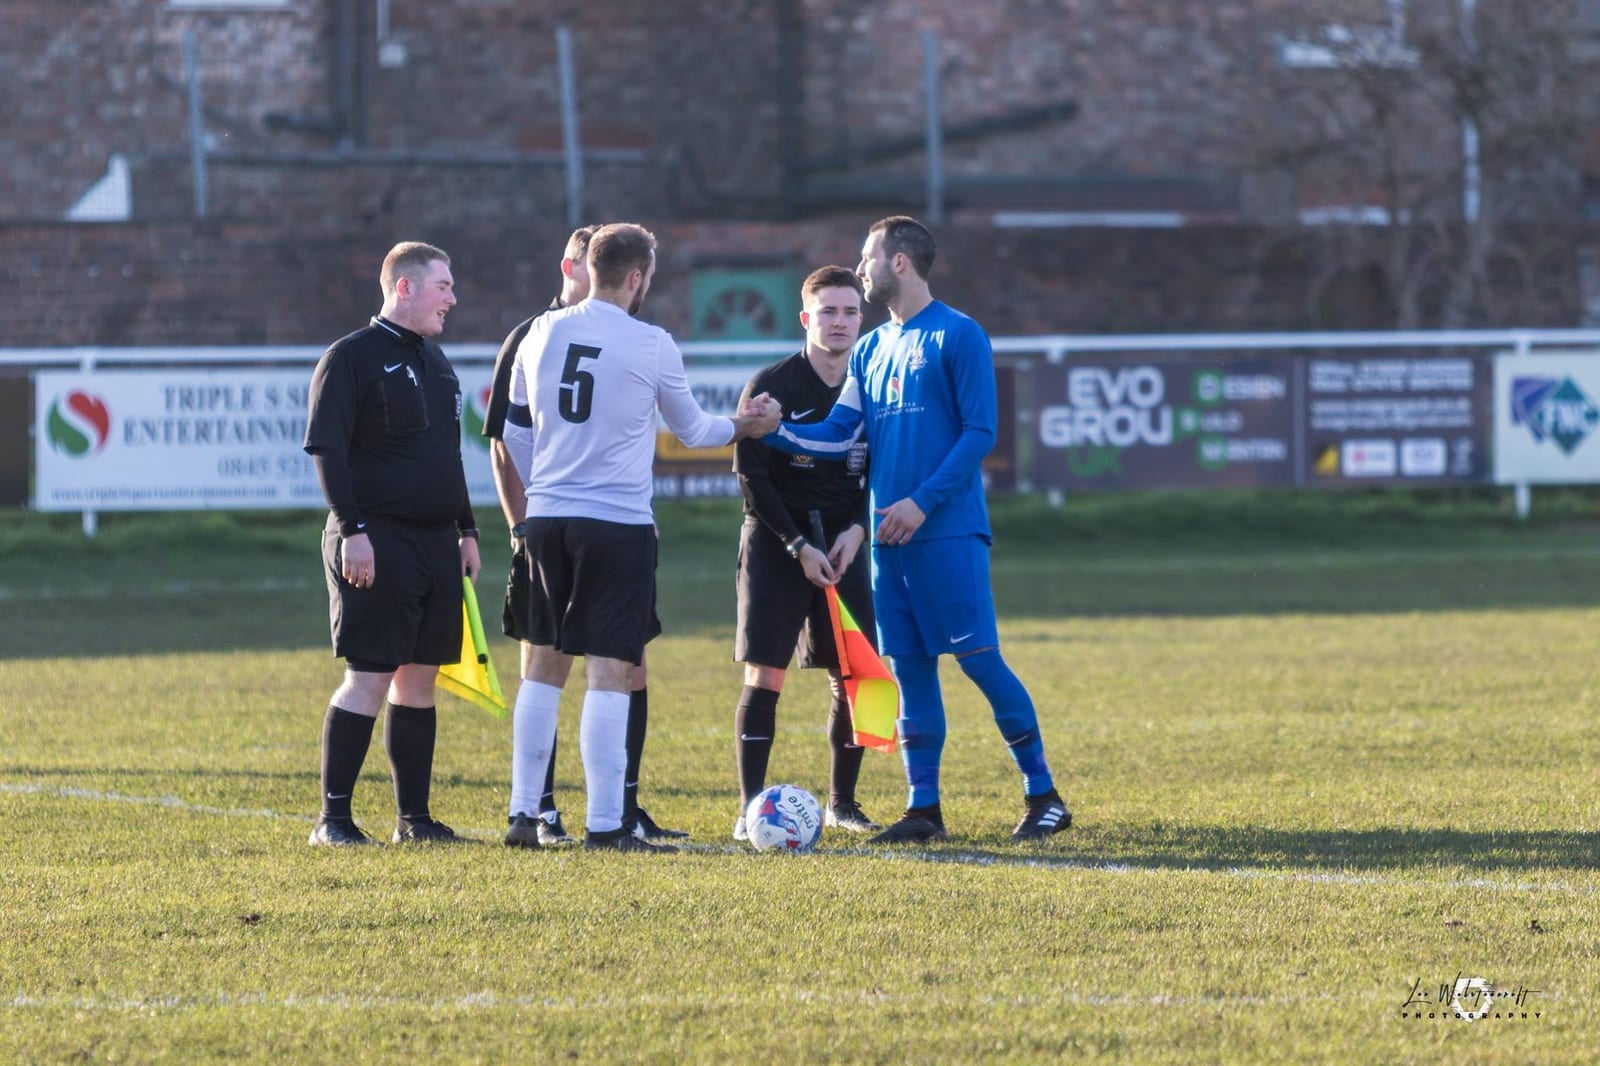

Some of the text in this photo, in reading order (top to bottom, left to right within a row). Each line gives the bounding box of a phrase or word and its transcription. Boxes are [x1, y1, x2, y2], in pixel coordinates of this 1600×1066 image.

[160, 384, 255, 412] TRIPLE
[264, 383, 280, 411] S
[558, 342, 602, 424] 5
[1068, 366, 1165, 408] EVO
[1068, 447, 1122, 476] UK
[788, 795, 815, 829] mitre
